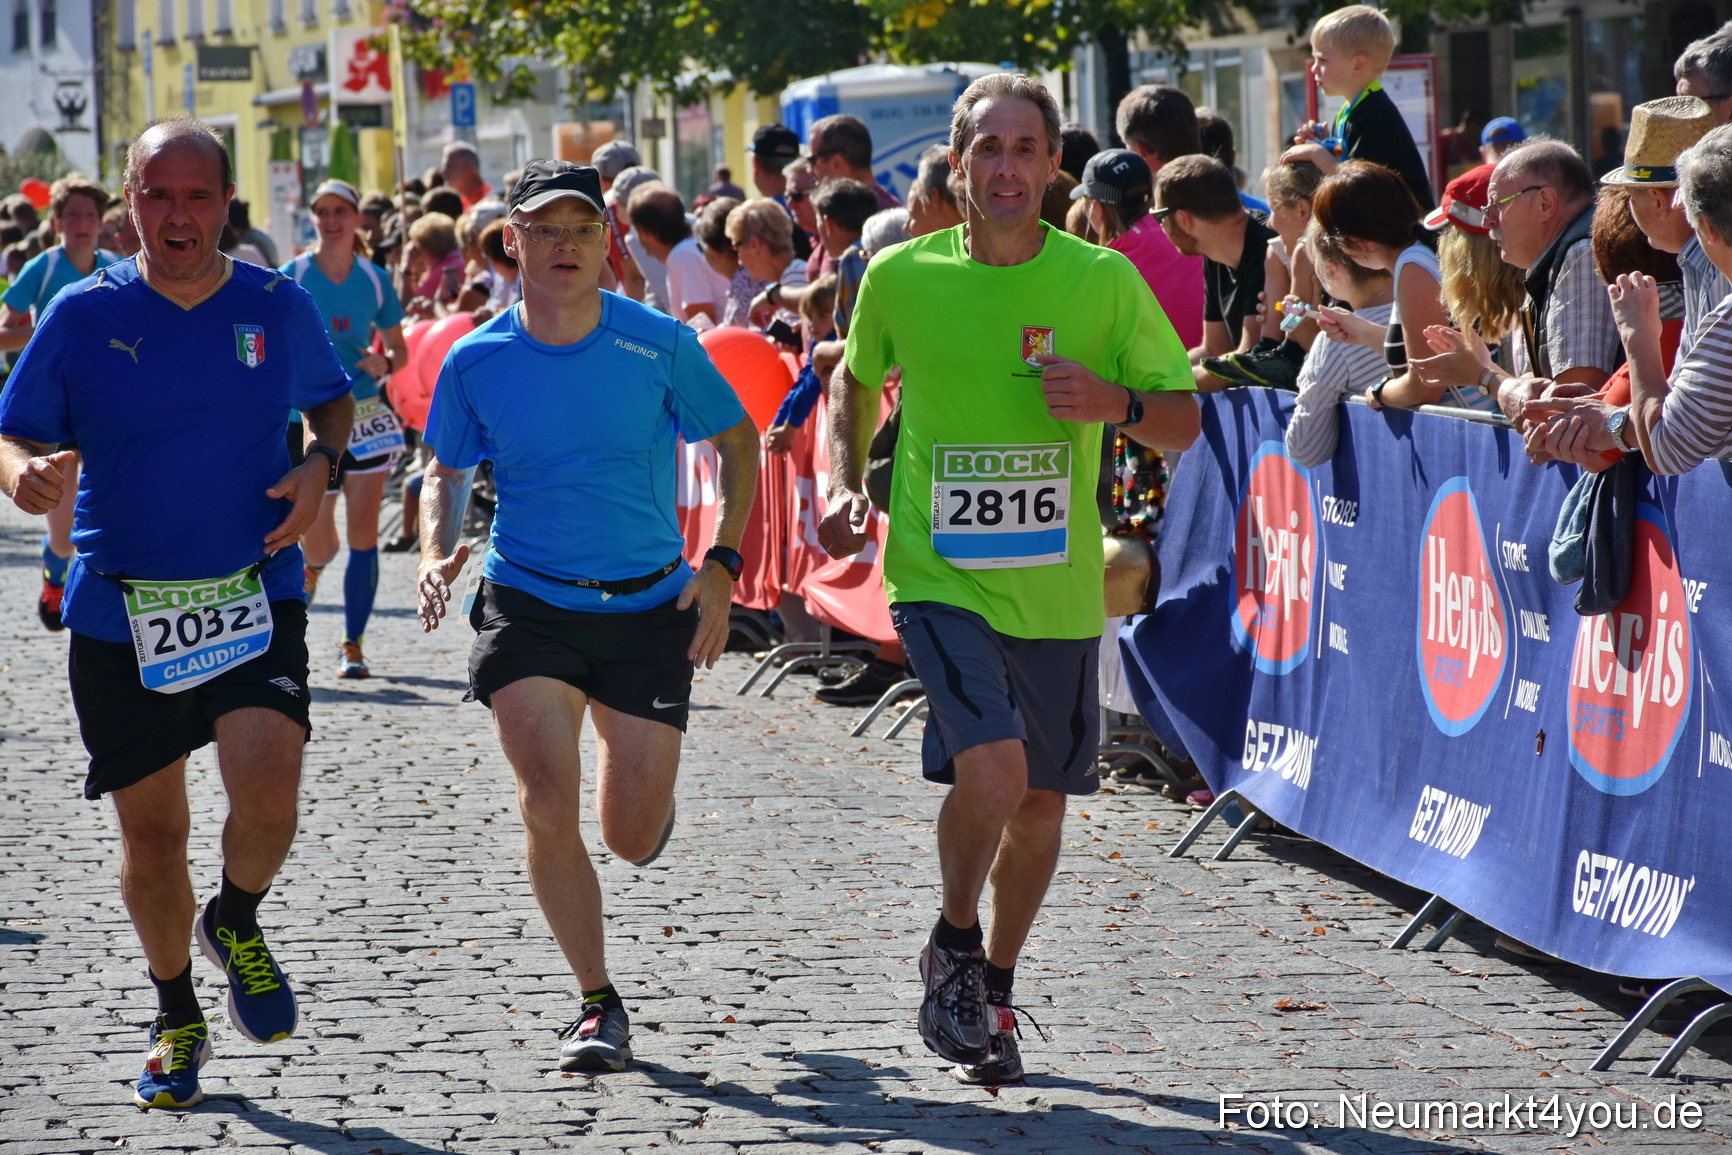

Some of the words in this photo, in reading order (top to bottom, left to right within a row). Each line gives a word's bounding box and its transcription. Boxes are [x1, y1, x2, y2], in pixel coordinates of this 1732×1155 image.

[352, 414, 396, 444] 2463
[943, 448, 1061, 478] BOCK
[949, 487, 1056, 526] 2816
[1322, 495, 1358, 528] STORE
[1502, 540, 1530, 573] STORE
[137, 574, 251, 609] BOCK
[1427, 534, 1502, 679] Hervis
[148, 605, 254, 656] 2032
[1328, 621, 1349, 655] MOBILE
[1519, 608, 1551, 643] ONLINE
[163, 643, 249, 680] CLAUDIO
[1432, 655, 1465, 688] SPORTS
[1514, 678, 1541, 713] MOBILE
[1574, 701, 1626, 740] SPORTS
